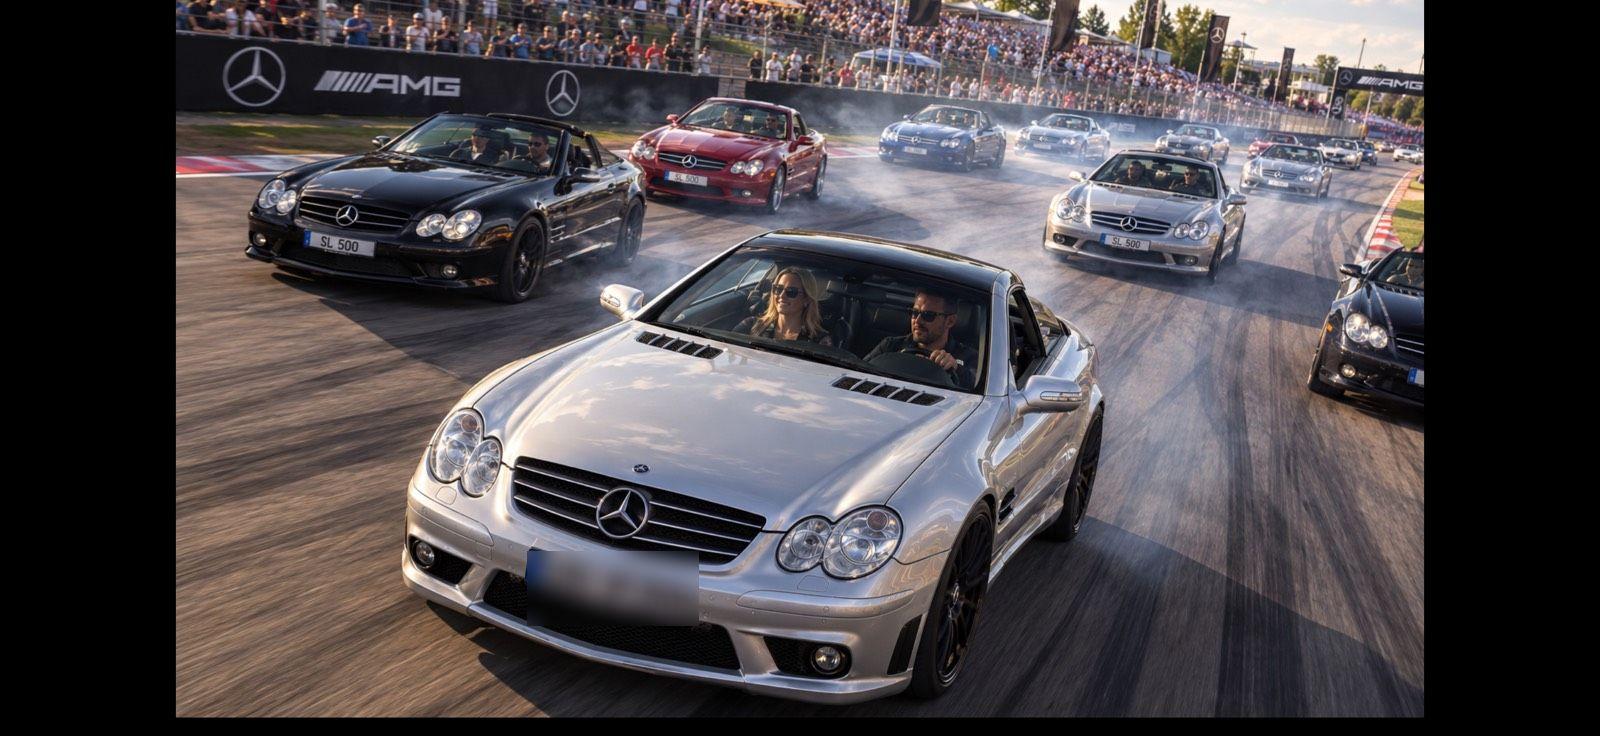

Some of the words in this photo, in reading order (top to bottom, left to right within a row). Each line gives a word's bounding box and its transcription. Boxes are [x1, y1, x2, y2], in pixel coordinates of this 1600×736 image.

[363, 73, 461, 97] AMG
[1379, 78, 1424, 90] AMG
[320, 236, 333, 249] SL
[338, 239, 359, 253] 500
[1112, 236, 1122, 246] SL
[1126, 239, 1141, 249] 500
